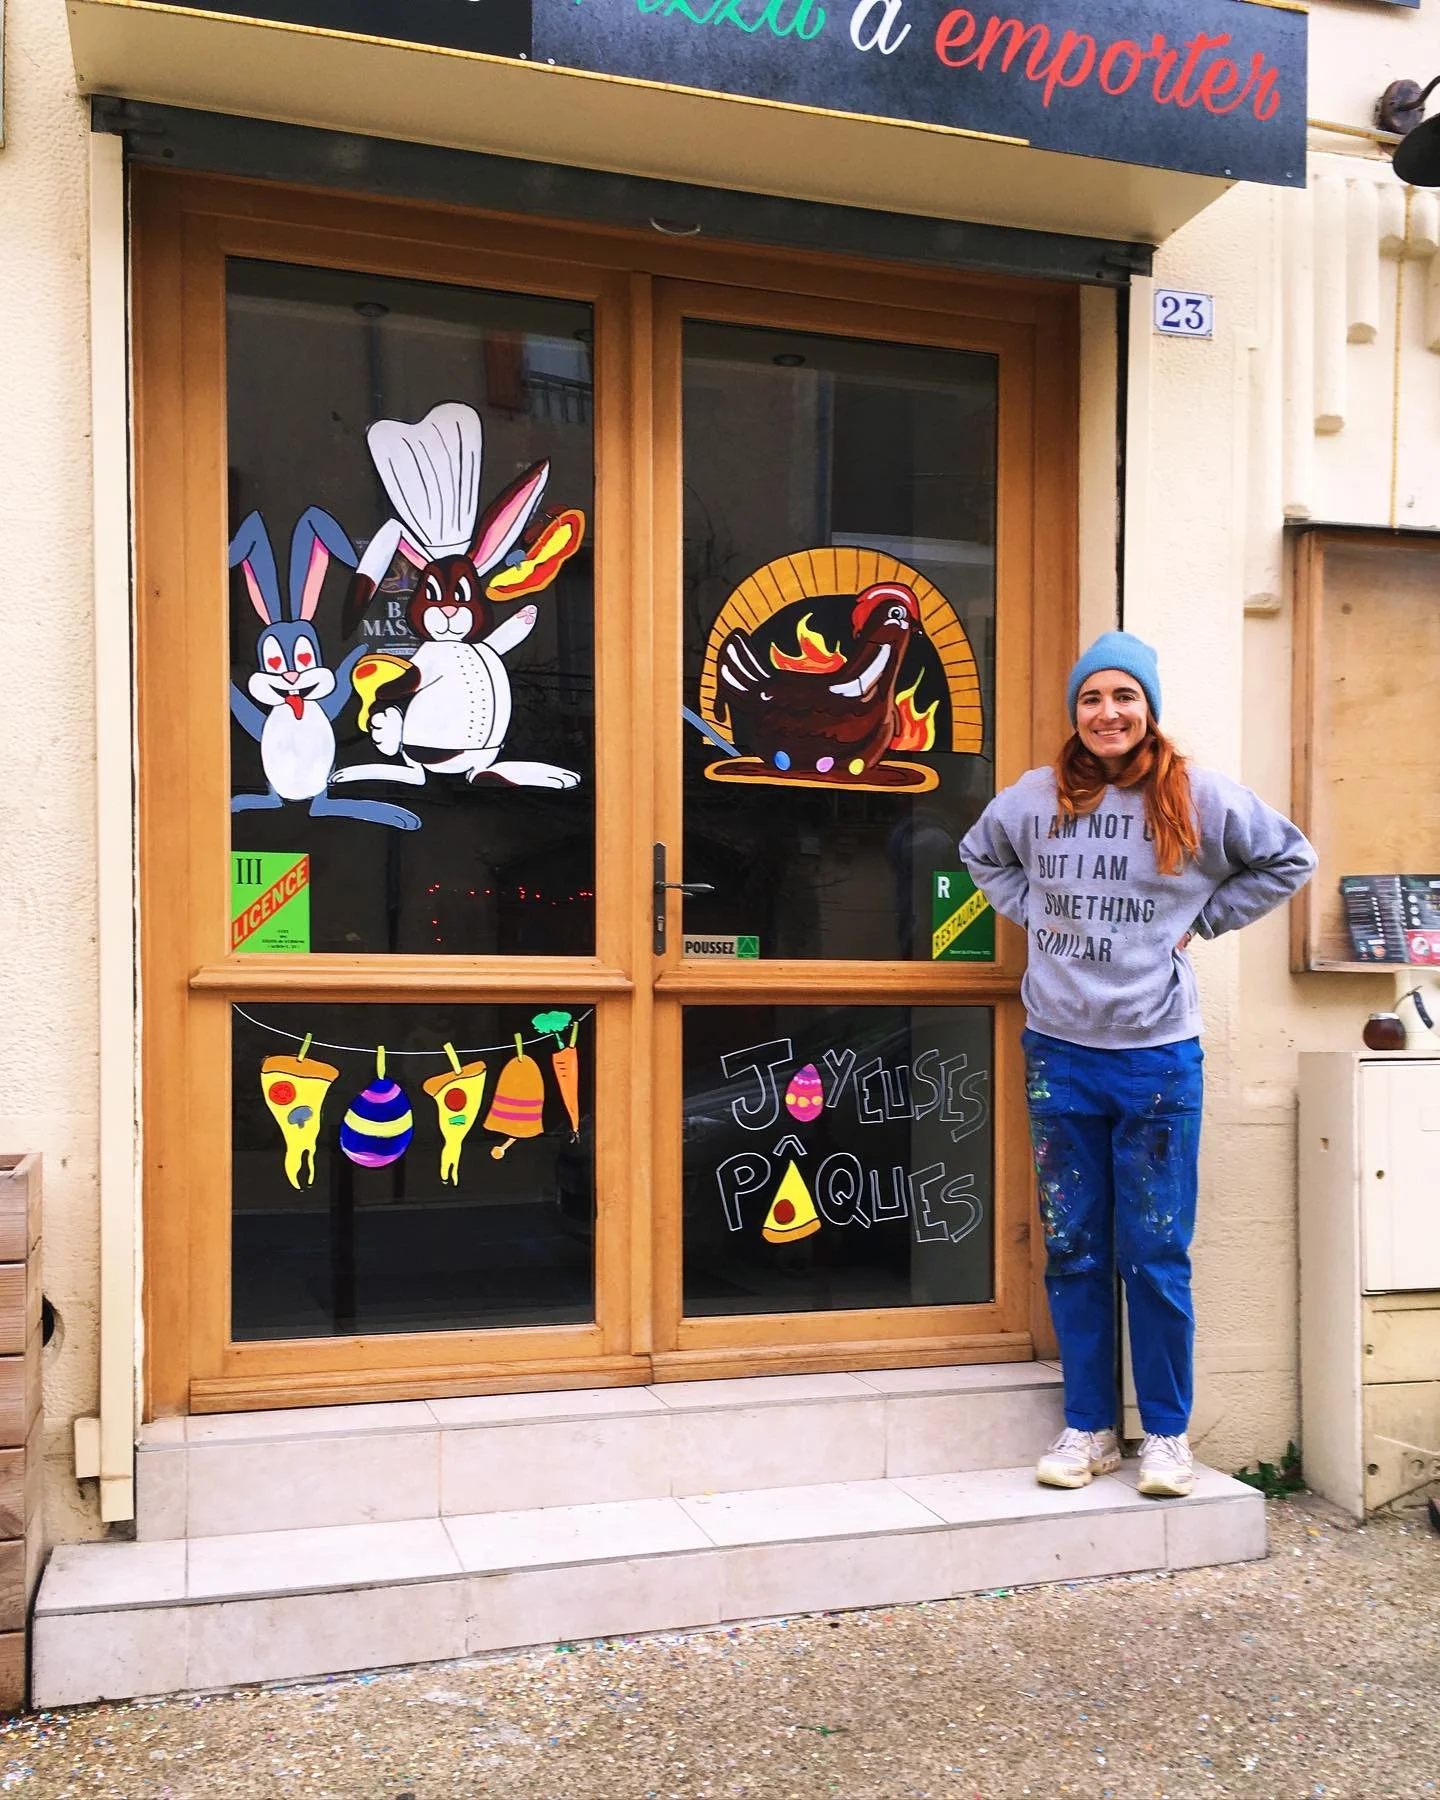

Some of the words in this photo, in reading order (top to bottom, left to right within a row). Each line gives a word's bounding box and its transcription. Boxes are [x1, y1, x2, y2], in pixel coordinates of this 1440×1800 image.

[935, 9, 1281, 121] emporter
[1162, 296, 1204, 330] 23
[1034, 815, 1039, 840] I
[1048, 814, 1078, 839] AM
[1088, 814, 1134, 839] NOT
[1038, 854, 1069, 879] BUT
[1076, 854, 1083, 879] I
[1092, 855, 1128, 881] AM
[233, 860, 308, 945] LICENCE
[937, 876, 951, 899] R
[1045, 892, 1156, 923] SOMETHING
[685, 941, 735, 955] POUSSEZ
[1036, 928, 1113, 963] SIMILAR
